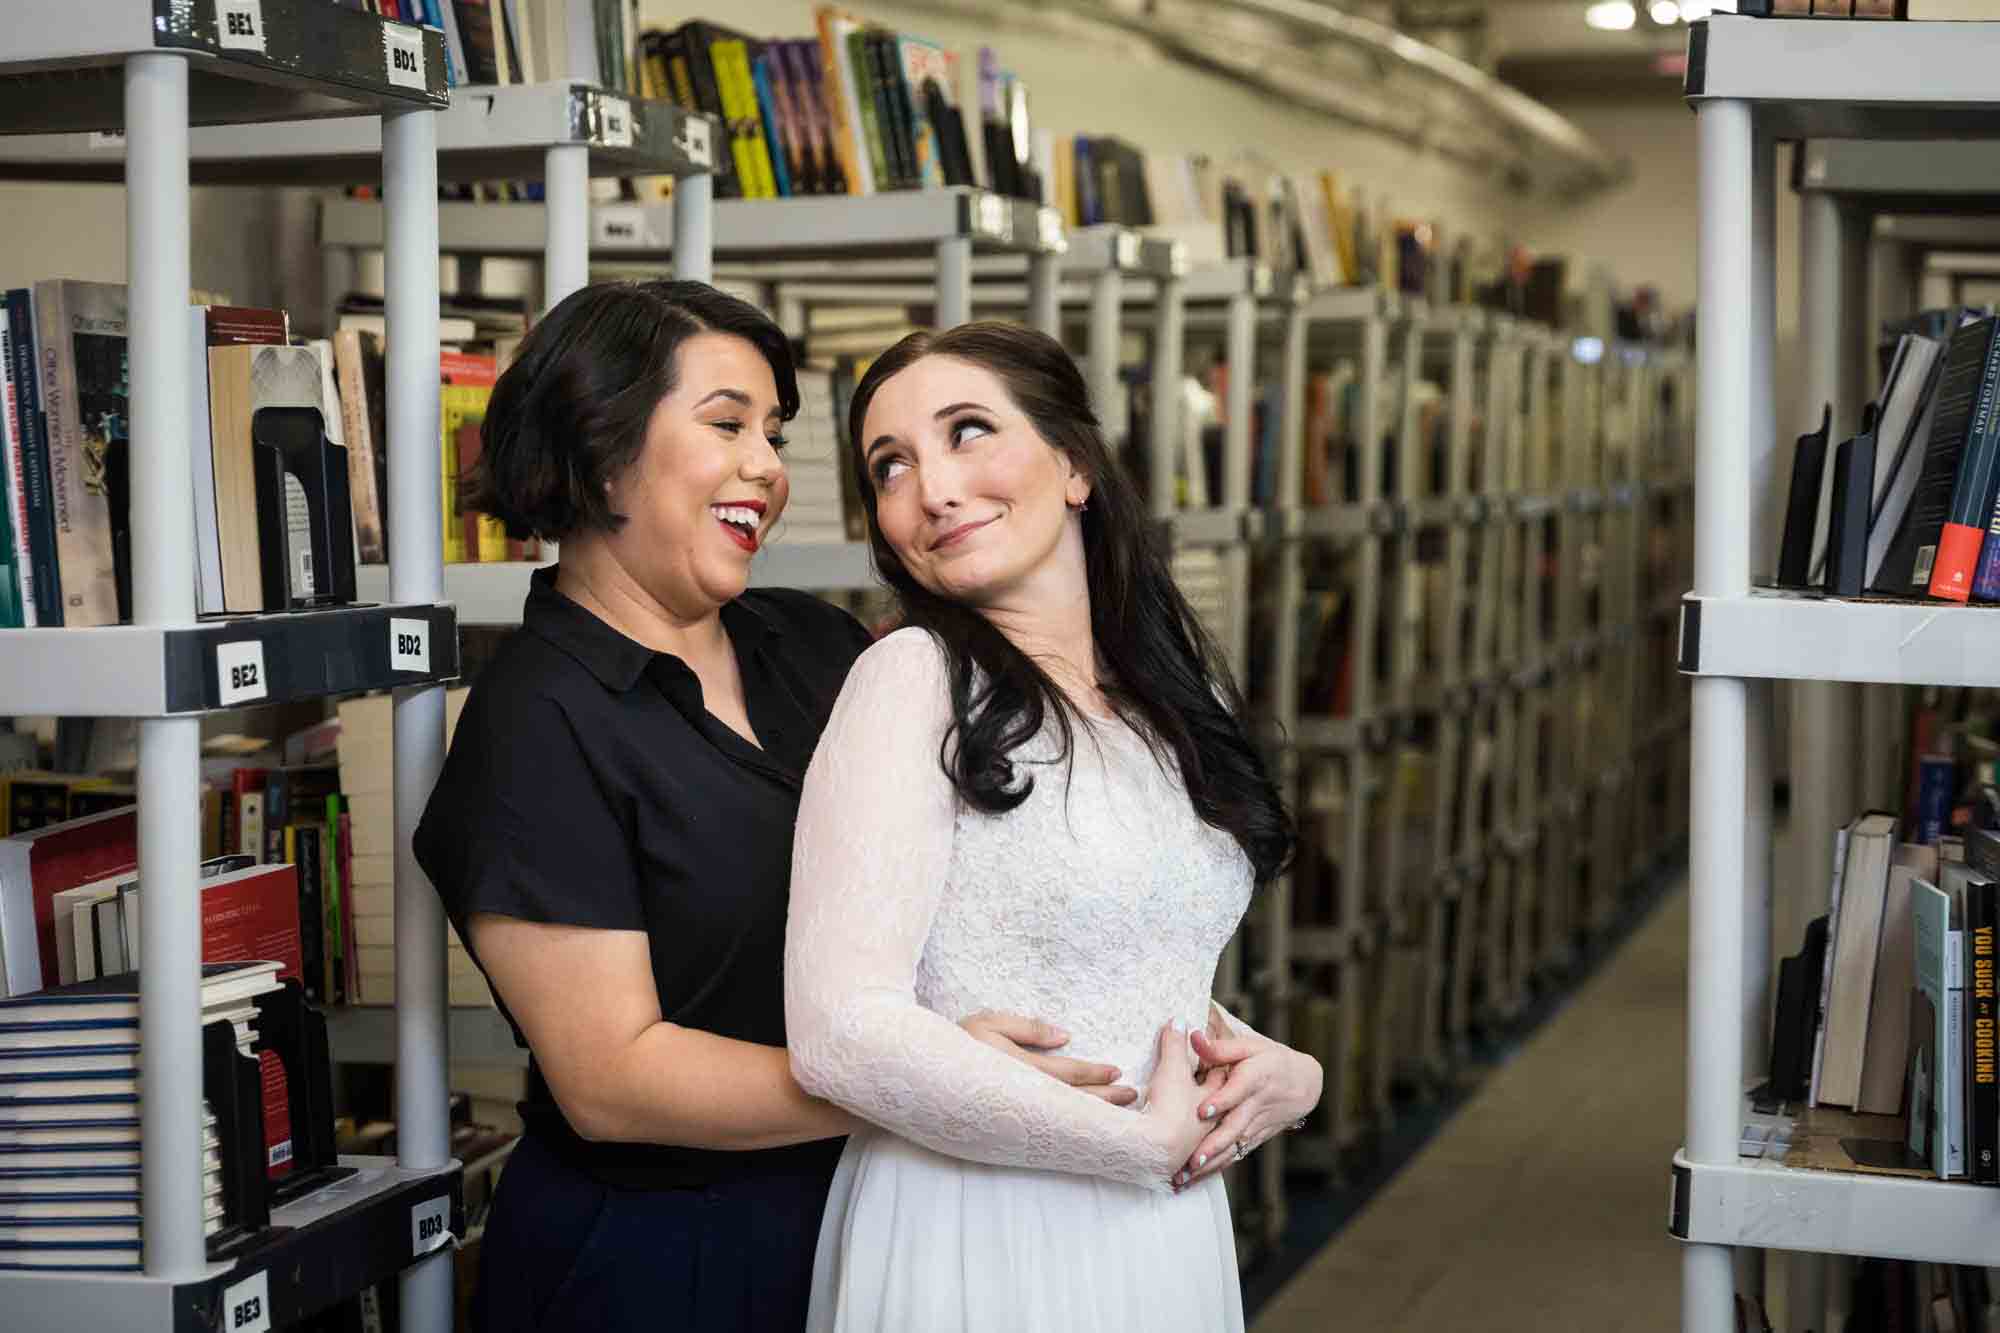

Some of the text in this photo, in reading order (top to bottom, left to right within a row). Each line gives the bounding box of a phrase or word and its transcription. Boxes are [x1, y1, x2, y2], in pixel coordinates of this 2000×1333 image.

[227, 12, 255, 35] BE1
[393, 47, 417, 72] BD1
[1976, 383, 1993, 434] FOREMAN
[54, 457, 71, 533] Movement
[398, 633, 421, 656] BD2
[232, 663, 258, 689] BE2
[1975, 926, 1993, 955] YOU
[1975, 959, 1993, 998] SUCK
[1975, 1018, 1994, 1083] COOKING
[419, 1214, 443, 1240] BD3
[234, 1296, 261, 1329] BE3
